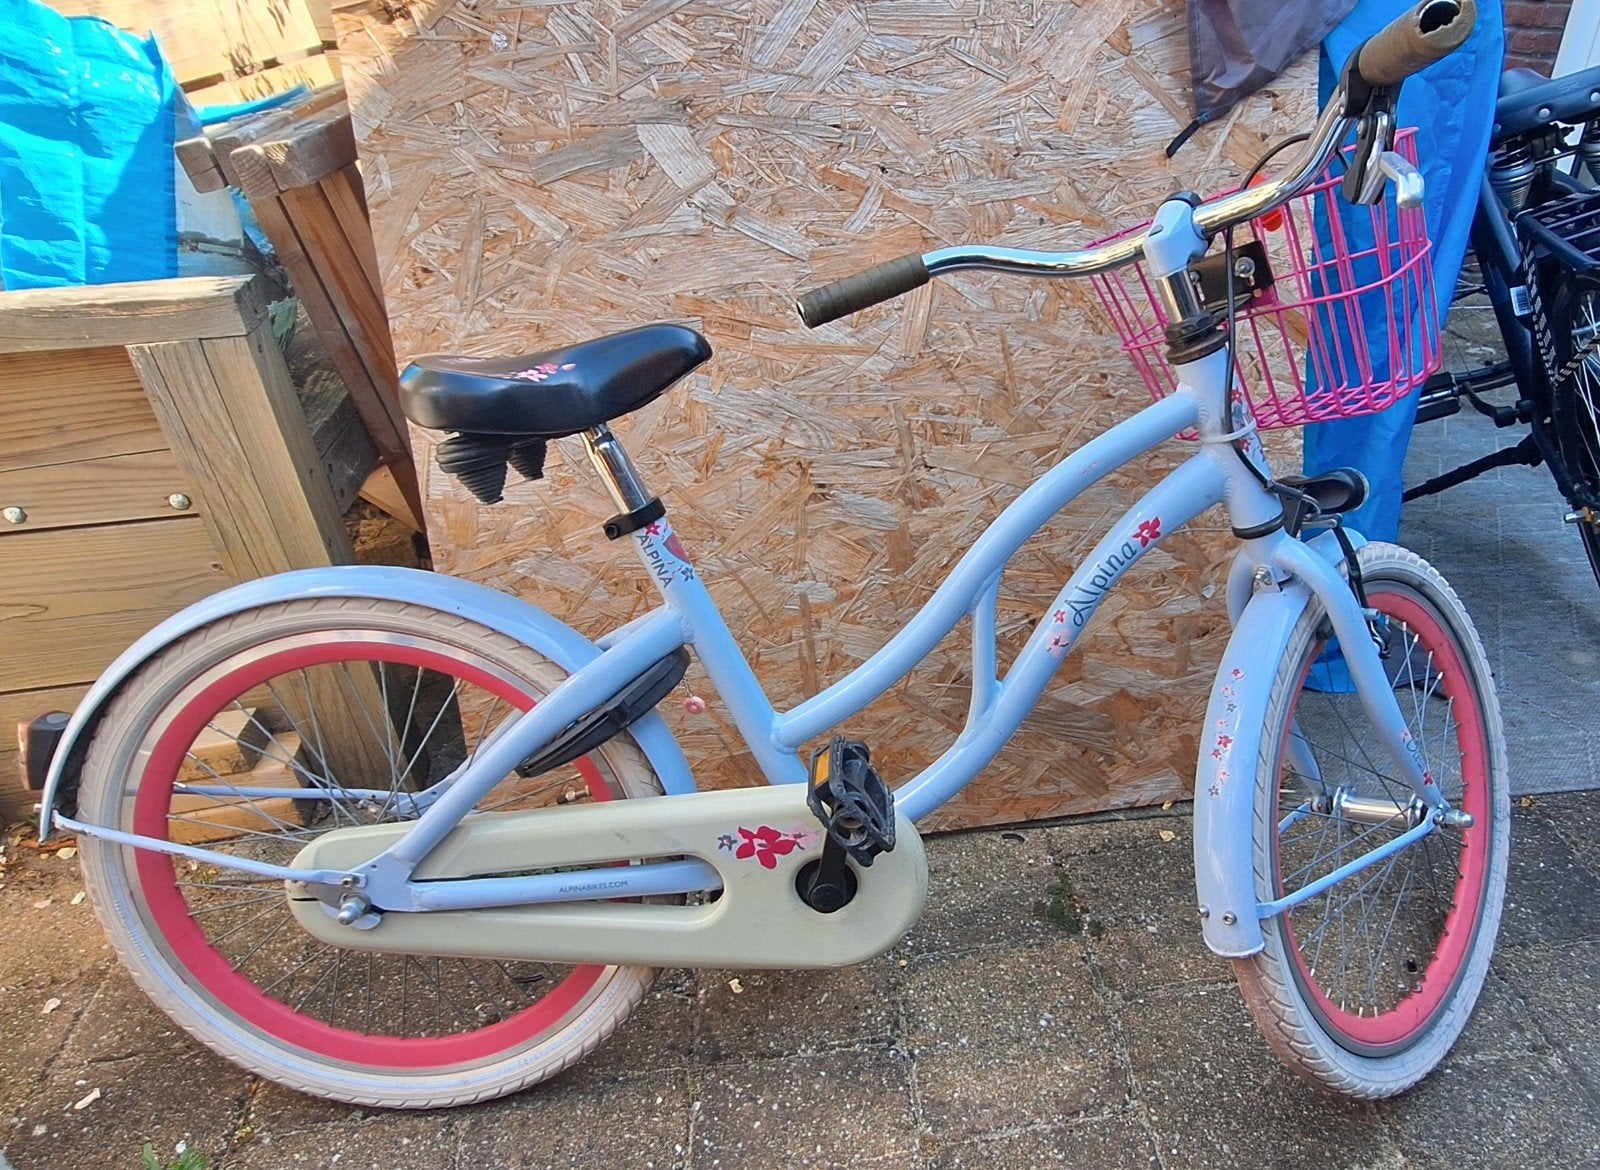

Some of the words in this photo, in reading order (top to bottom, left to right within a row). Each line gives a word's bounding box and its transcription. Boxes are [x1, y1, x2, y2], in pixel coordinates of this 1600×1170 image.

[636, 535, 673, 588] ALPINA
[1064, 541, 1137, 627] Alpina
[559, 880, 628, 893] ALPINABIKES.COM
